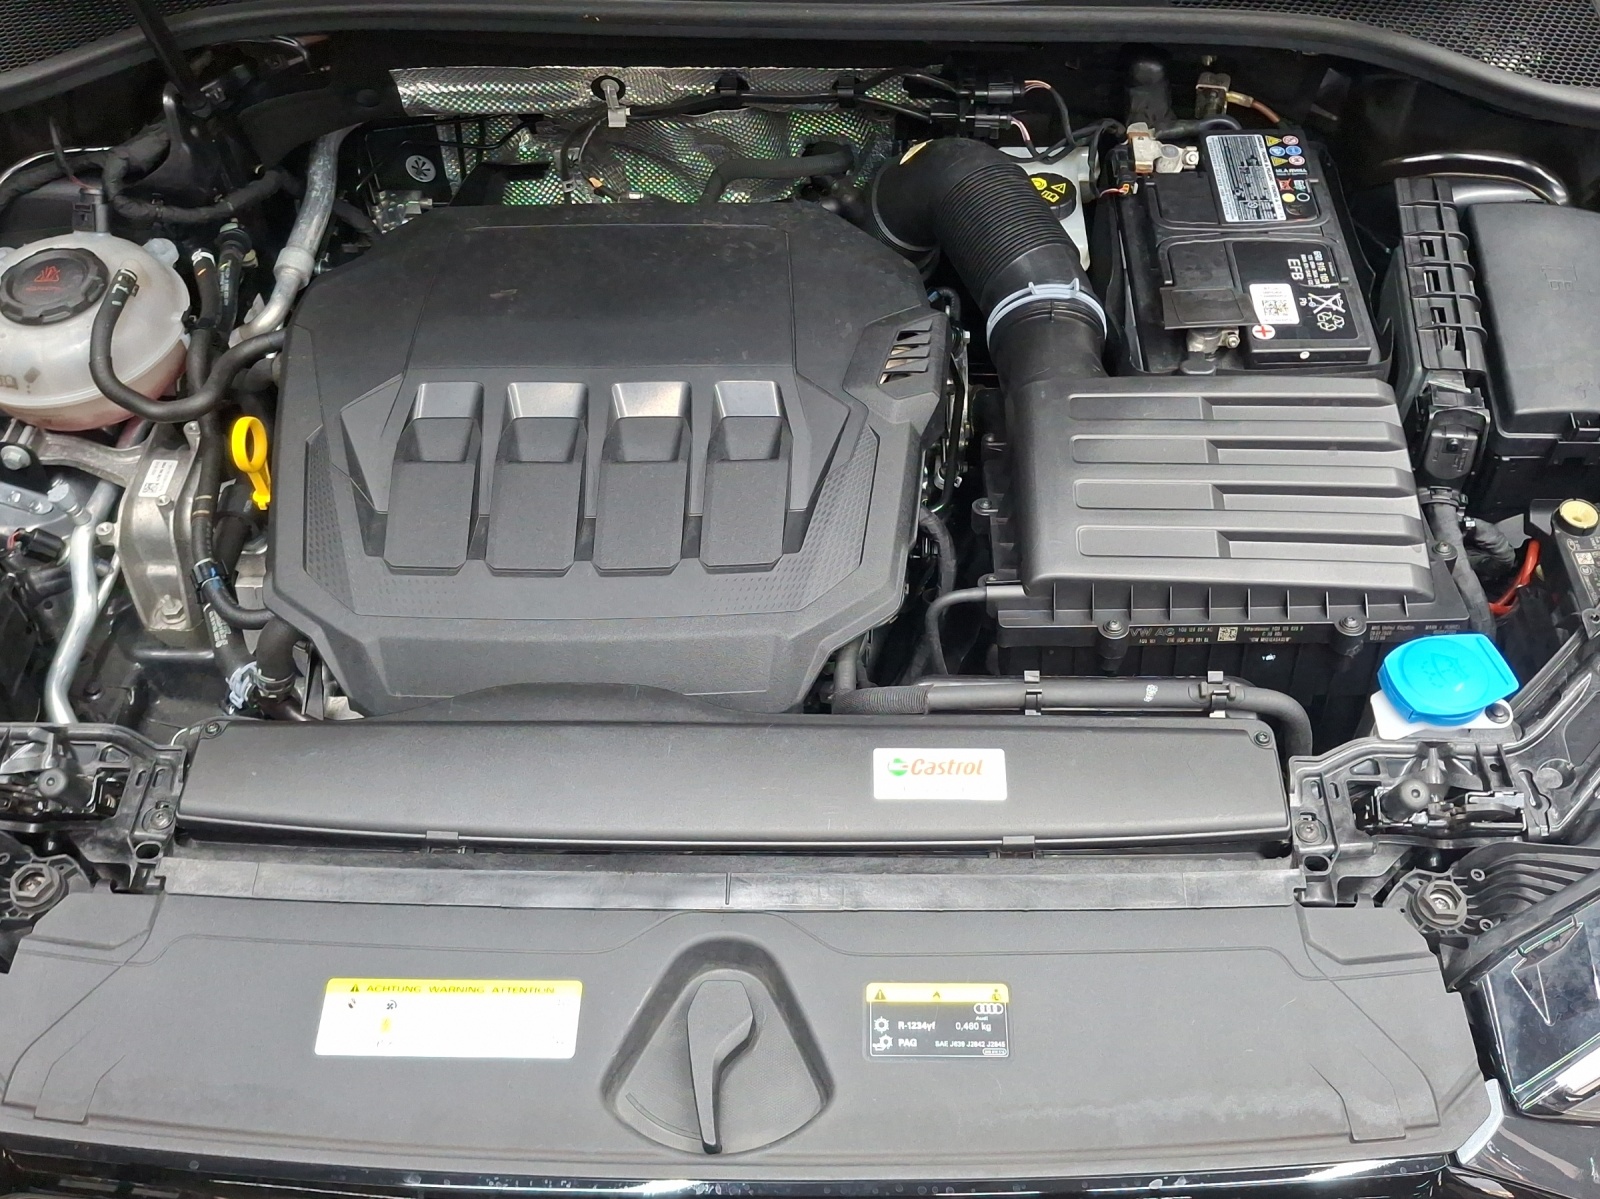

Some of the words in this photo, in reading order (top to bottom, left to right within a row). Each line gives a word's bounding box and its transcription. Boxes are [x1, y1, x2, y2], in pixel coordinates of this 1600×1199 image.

[1287, 258, 1305, 281] EFB
[1129, 627, 1153, 637] VW
[1154, 627, 1175, 637] AG
[910, 758, 983, 776] Castrol
[366, 985, 422, 993] ACHTUNG
[429, 985, 485, 993] WARNING
[492, 986, 555, 994] ATTENTION
[897, 1021, 936, 1032] R-1234yf
[981, 1021, 992, 1032] kg
[898, 1038, 918, 1048] PAG
[934, 1040, 949, 1048] SAE
